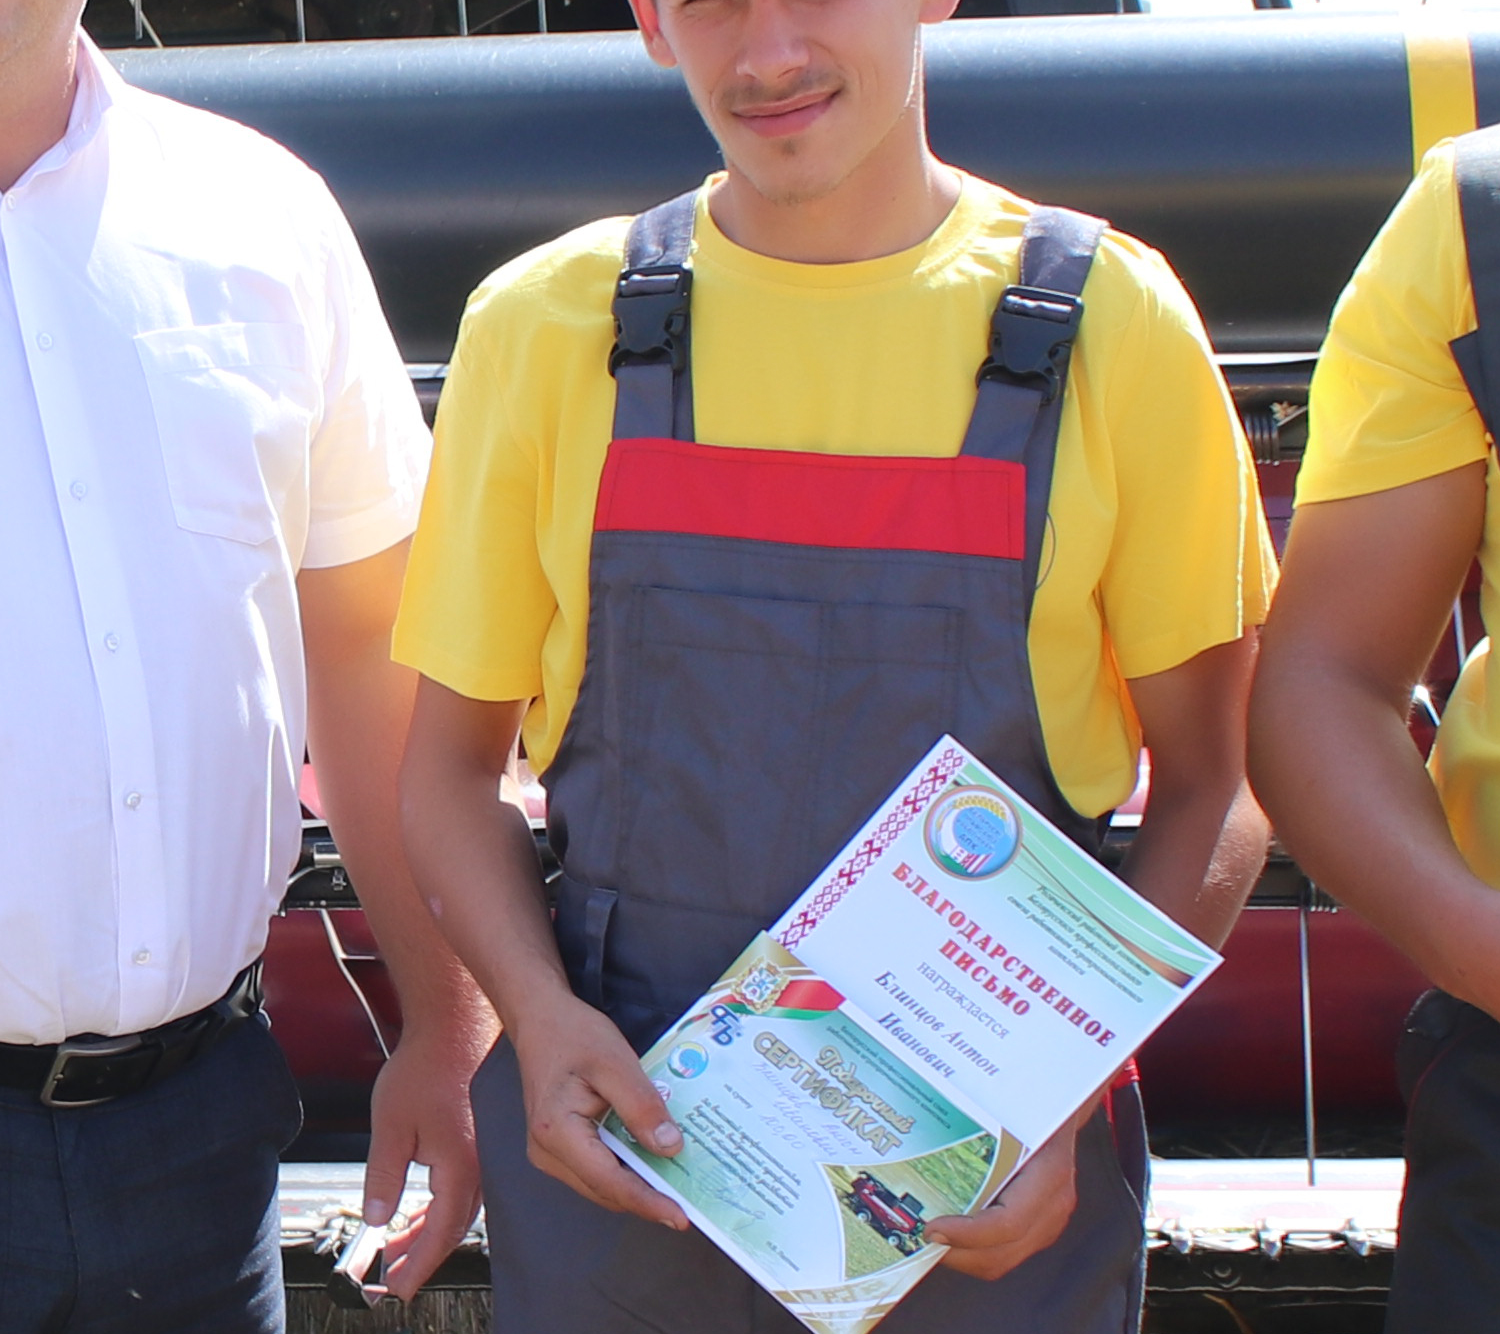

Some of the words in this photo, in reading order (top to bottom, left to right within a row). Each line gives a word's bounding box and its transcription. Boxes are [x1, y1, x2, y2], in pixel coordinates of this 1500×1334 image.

[891, 861, 1116, 1047] БЛАГОДАРСТВЕННОЕ
[938, 938, 1031, 1016] ПИСЬМО
[874, 970, 945, 1032] Блинцов
[942, 1030, 1000, 1076] Антон
[878, 1011, 956, 1078] Иванович
[917, 961, 1010, 1040] награждается
[753, 1031, 903, 1156] СЕРТИФИКАТ
[815, 1045, 916, 1134] Подарочный
